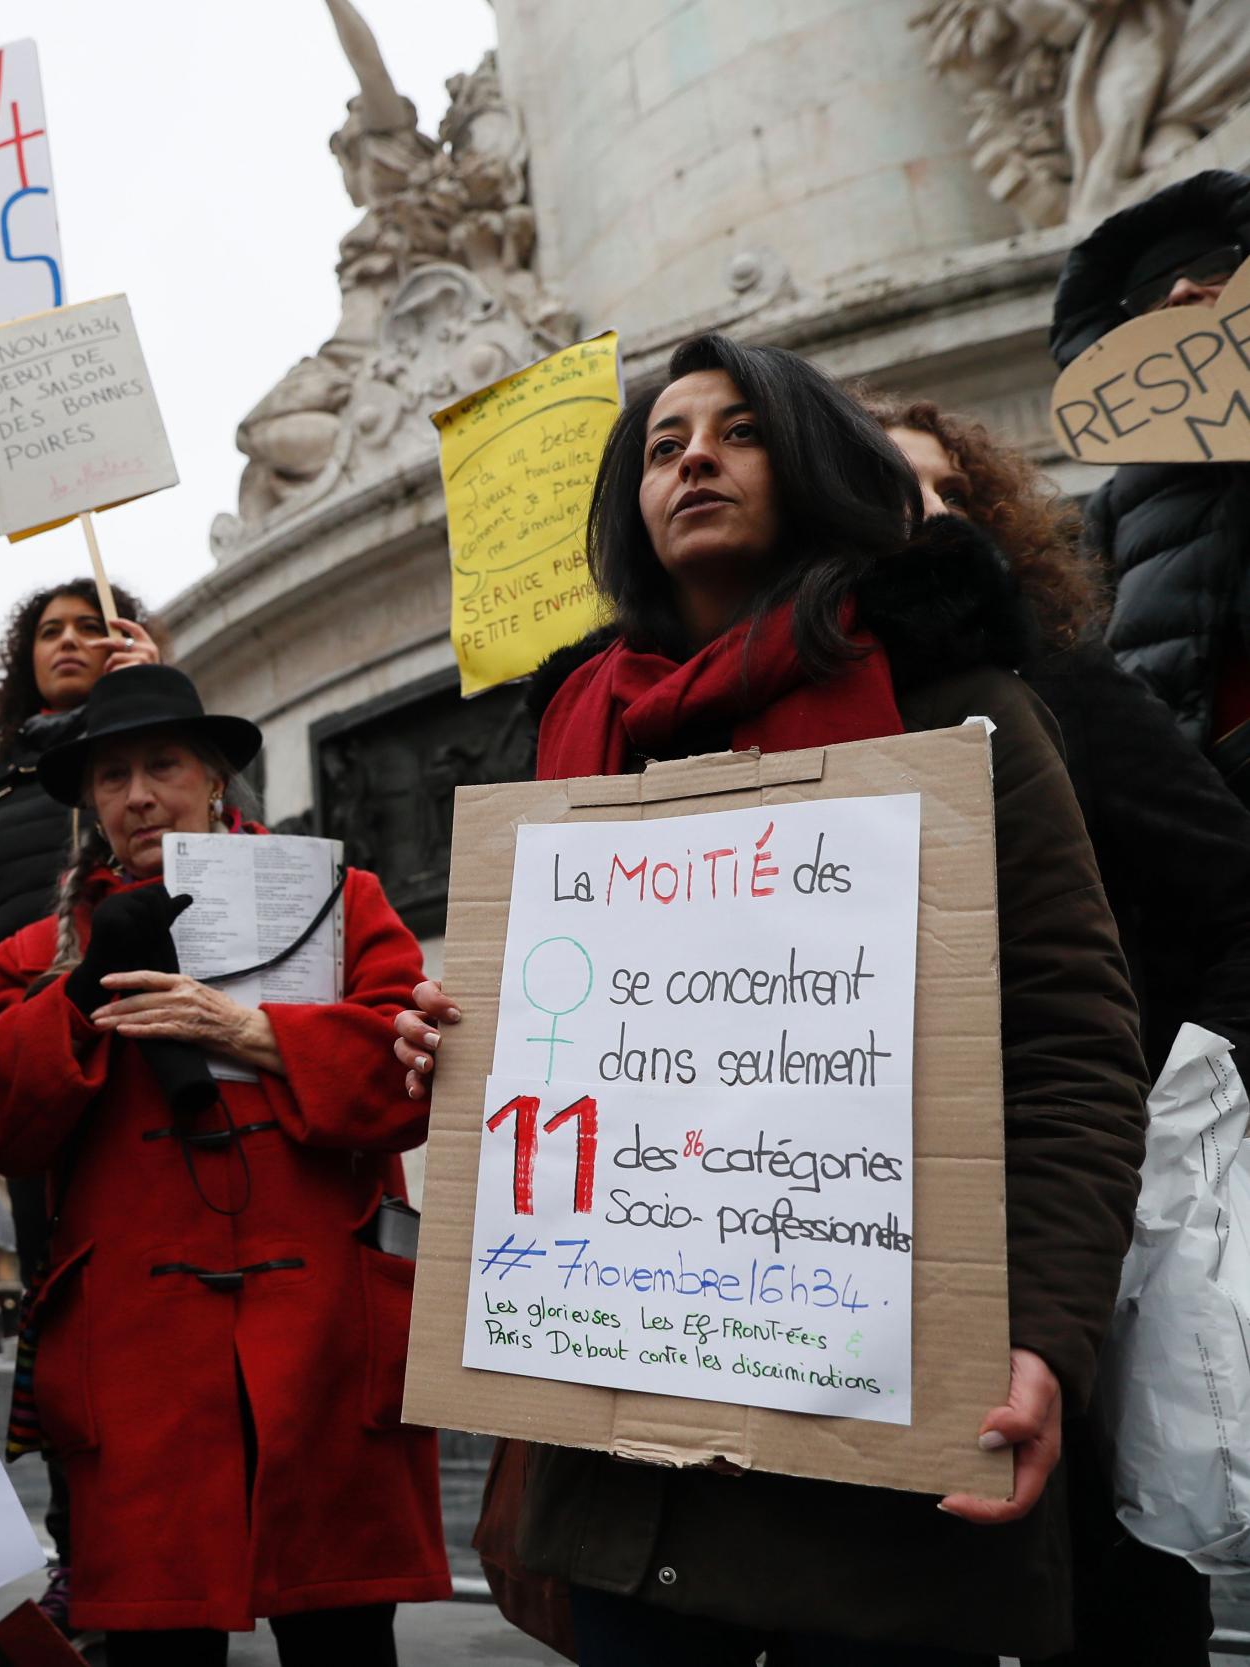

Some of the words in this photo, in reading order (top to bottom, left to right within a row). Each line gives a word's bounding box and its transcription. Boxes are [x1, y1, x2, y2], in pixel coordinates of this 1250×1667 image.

[71, 346, 105, 369] DE
[37, 364, 116, 400] SAISON
[62, 378, 144, 417] BONNES
[4, 423, 96, 472] POIRES
[508, 449, 528, 466] un
[463, 572, 543, 625] SERVICE
[553, 550, 589, 576] PUB
[461, 615, 520, 660] PETITE
[554, 854, 595, 902] La
[793, 833, 852, 894] des
[610, 968, 653, 1005] se
[666, 946, 875, 1005] concentrent
[599, 1022, 696, 1084] dans
[718, 1030, 892, 1087] seulement
[485, 1094, 598, 1215] 11
[614, 1124, 678, 1172] des
[683, 1129, 704, 1158] 86
[701, 1131, 902, 1193] catégories
[484, 1291, 518, 1315] Les
[641, 1306, 674, 1331] Les
[546, 1330, 629, 1361] Debout
[639, 1345, 688, 1367] contre
[696, 1346, 722, 1371] les
